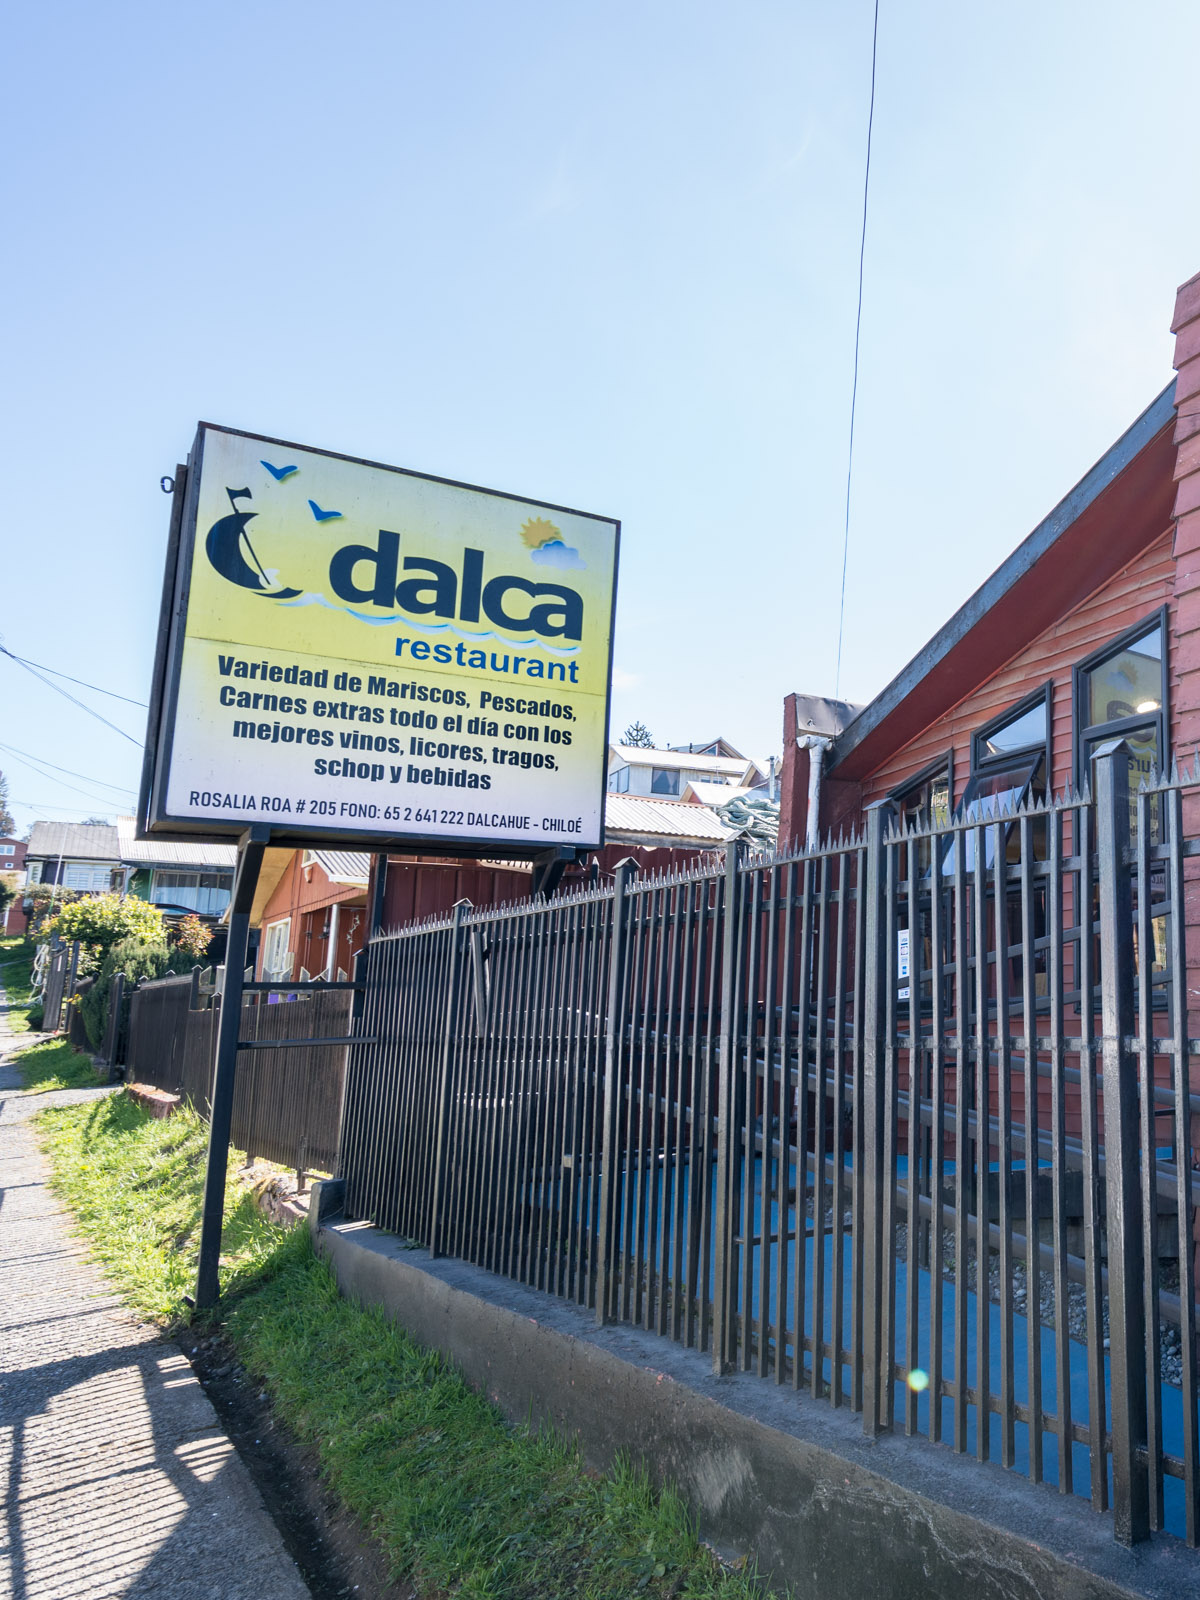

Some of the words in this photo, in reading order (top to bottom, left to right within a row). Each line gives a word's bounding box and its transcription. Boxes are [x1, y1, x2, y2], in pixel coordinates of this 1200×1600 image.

[328, 529, 584, 642] dalca
[395, 637, 580, 684] restaurant
[218, 655, 328, 689] Variedad
[333, 672, 362, 693] de
[367, 676, 471, 708] Mariscos,
[479, 691, 577, 723] Pescados,
[219, 686, 307, 715] Carnes
[312, 701, 385, 724] extras
[389, 708, 438, 730] todo
[442, 715, 463, 733] el
[467, 717, 499, 737] día
[503, 723, 540, 742] con
[543, 726, 572, 746] los
[232, 721, 334, 747] mejores
[339, 731, 405, 756] vinos,
[409, 737, 487, 765] licores,
[492, 747, 559, 772] tragos,
[314, 757, 385, 782] schop
[389, 766, 403, 784] y
[406, 765, 492, 790] bebidas
[189, 791, 257, 810] ROSALIA
[260, 797, 292, 813] ROA
[295, 799, 306, 814] #
[309, 800, 337, 815] 205
[340, 802, 381, 819] FONO:
[383, 806, 400, 820] 65
[403, 808, 412, 821] 2
[414, 809, 437, 822] 641
[440, 810, 464, 824] 222
[467, 812, 531, 829] DALCAHUE
[542, 816, 582, 834] CHILOÉ
